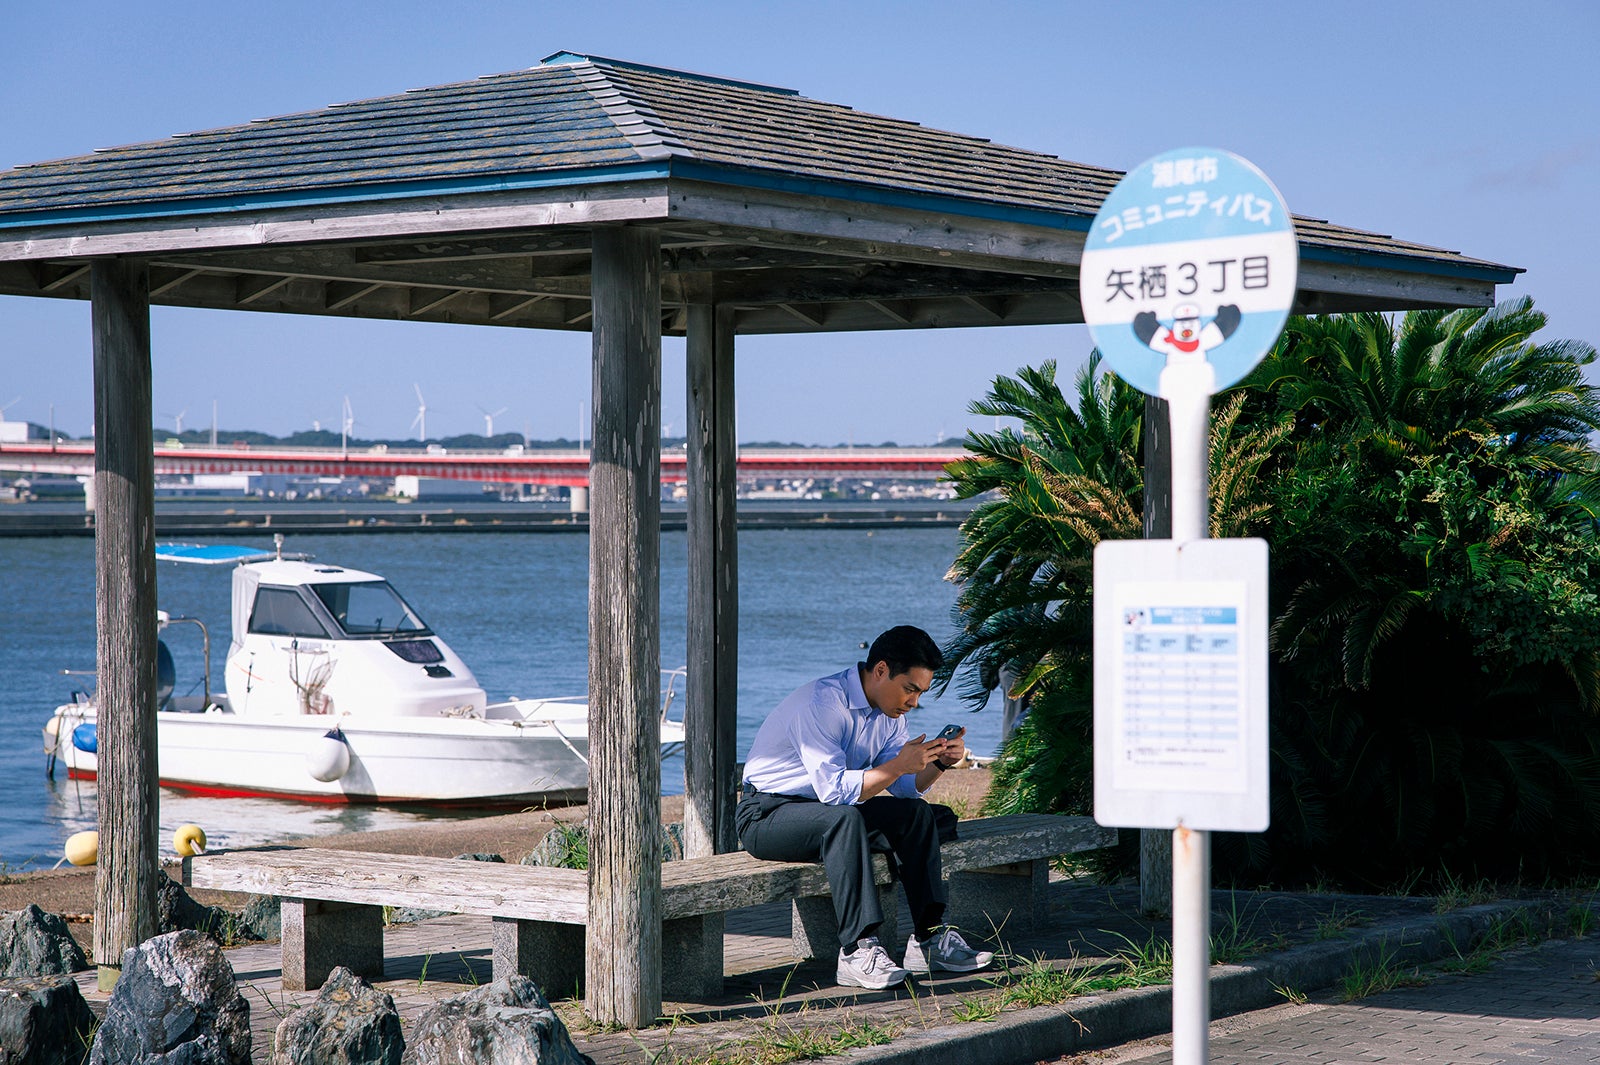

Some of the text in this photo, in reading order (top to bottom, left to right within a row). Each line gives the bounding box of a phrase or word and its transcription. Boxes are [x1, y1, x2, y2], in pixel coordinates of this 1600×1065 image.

[1101, 190, 1273, 243] コミュニティバス
[1106, 255, 1269, 303] 矢栖3丁目
